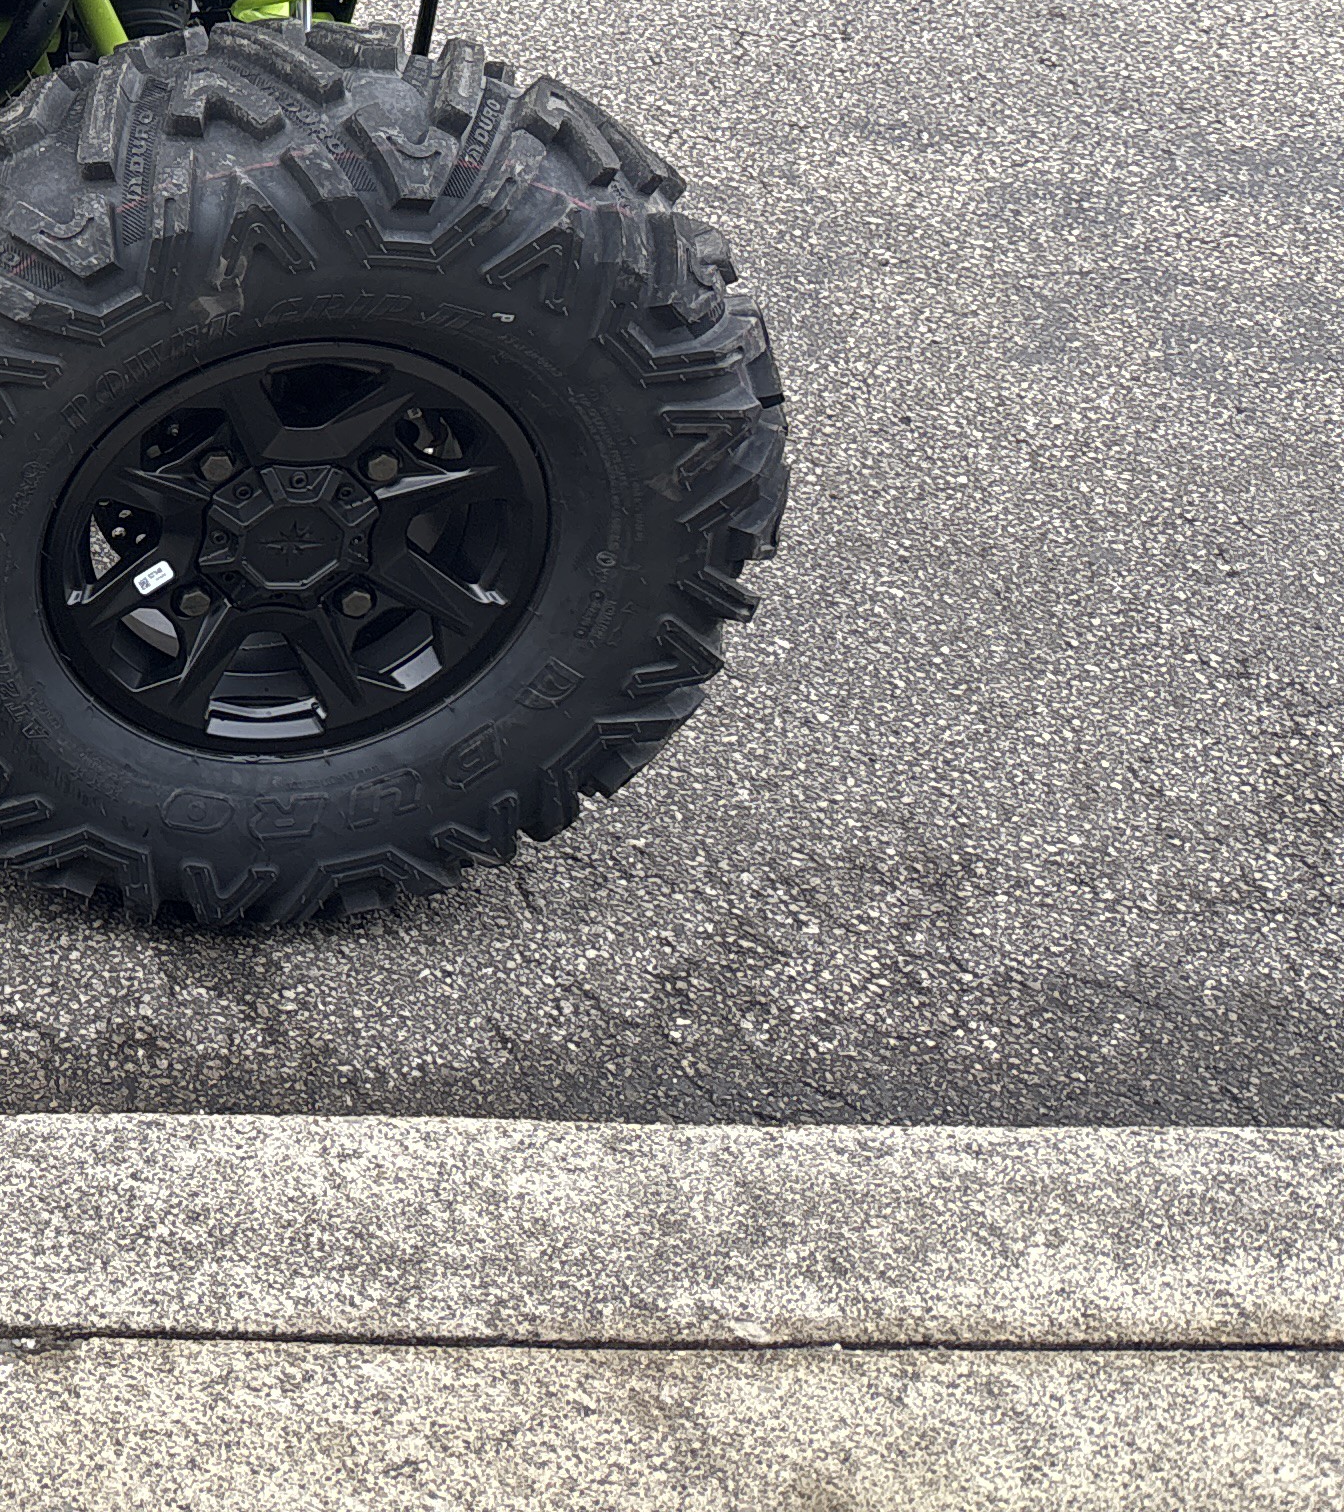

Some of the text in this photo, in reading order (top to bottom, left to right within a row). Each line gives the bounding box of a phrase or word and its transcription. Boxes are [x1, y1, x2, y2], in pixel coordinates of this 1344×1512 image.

[128, 110, 154, 174] DURO
[475, 98, 501, 145] DURO
[158, 722, 504, 840] DURO
